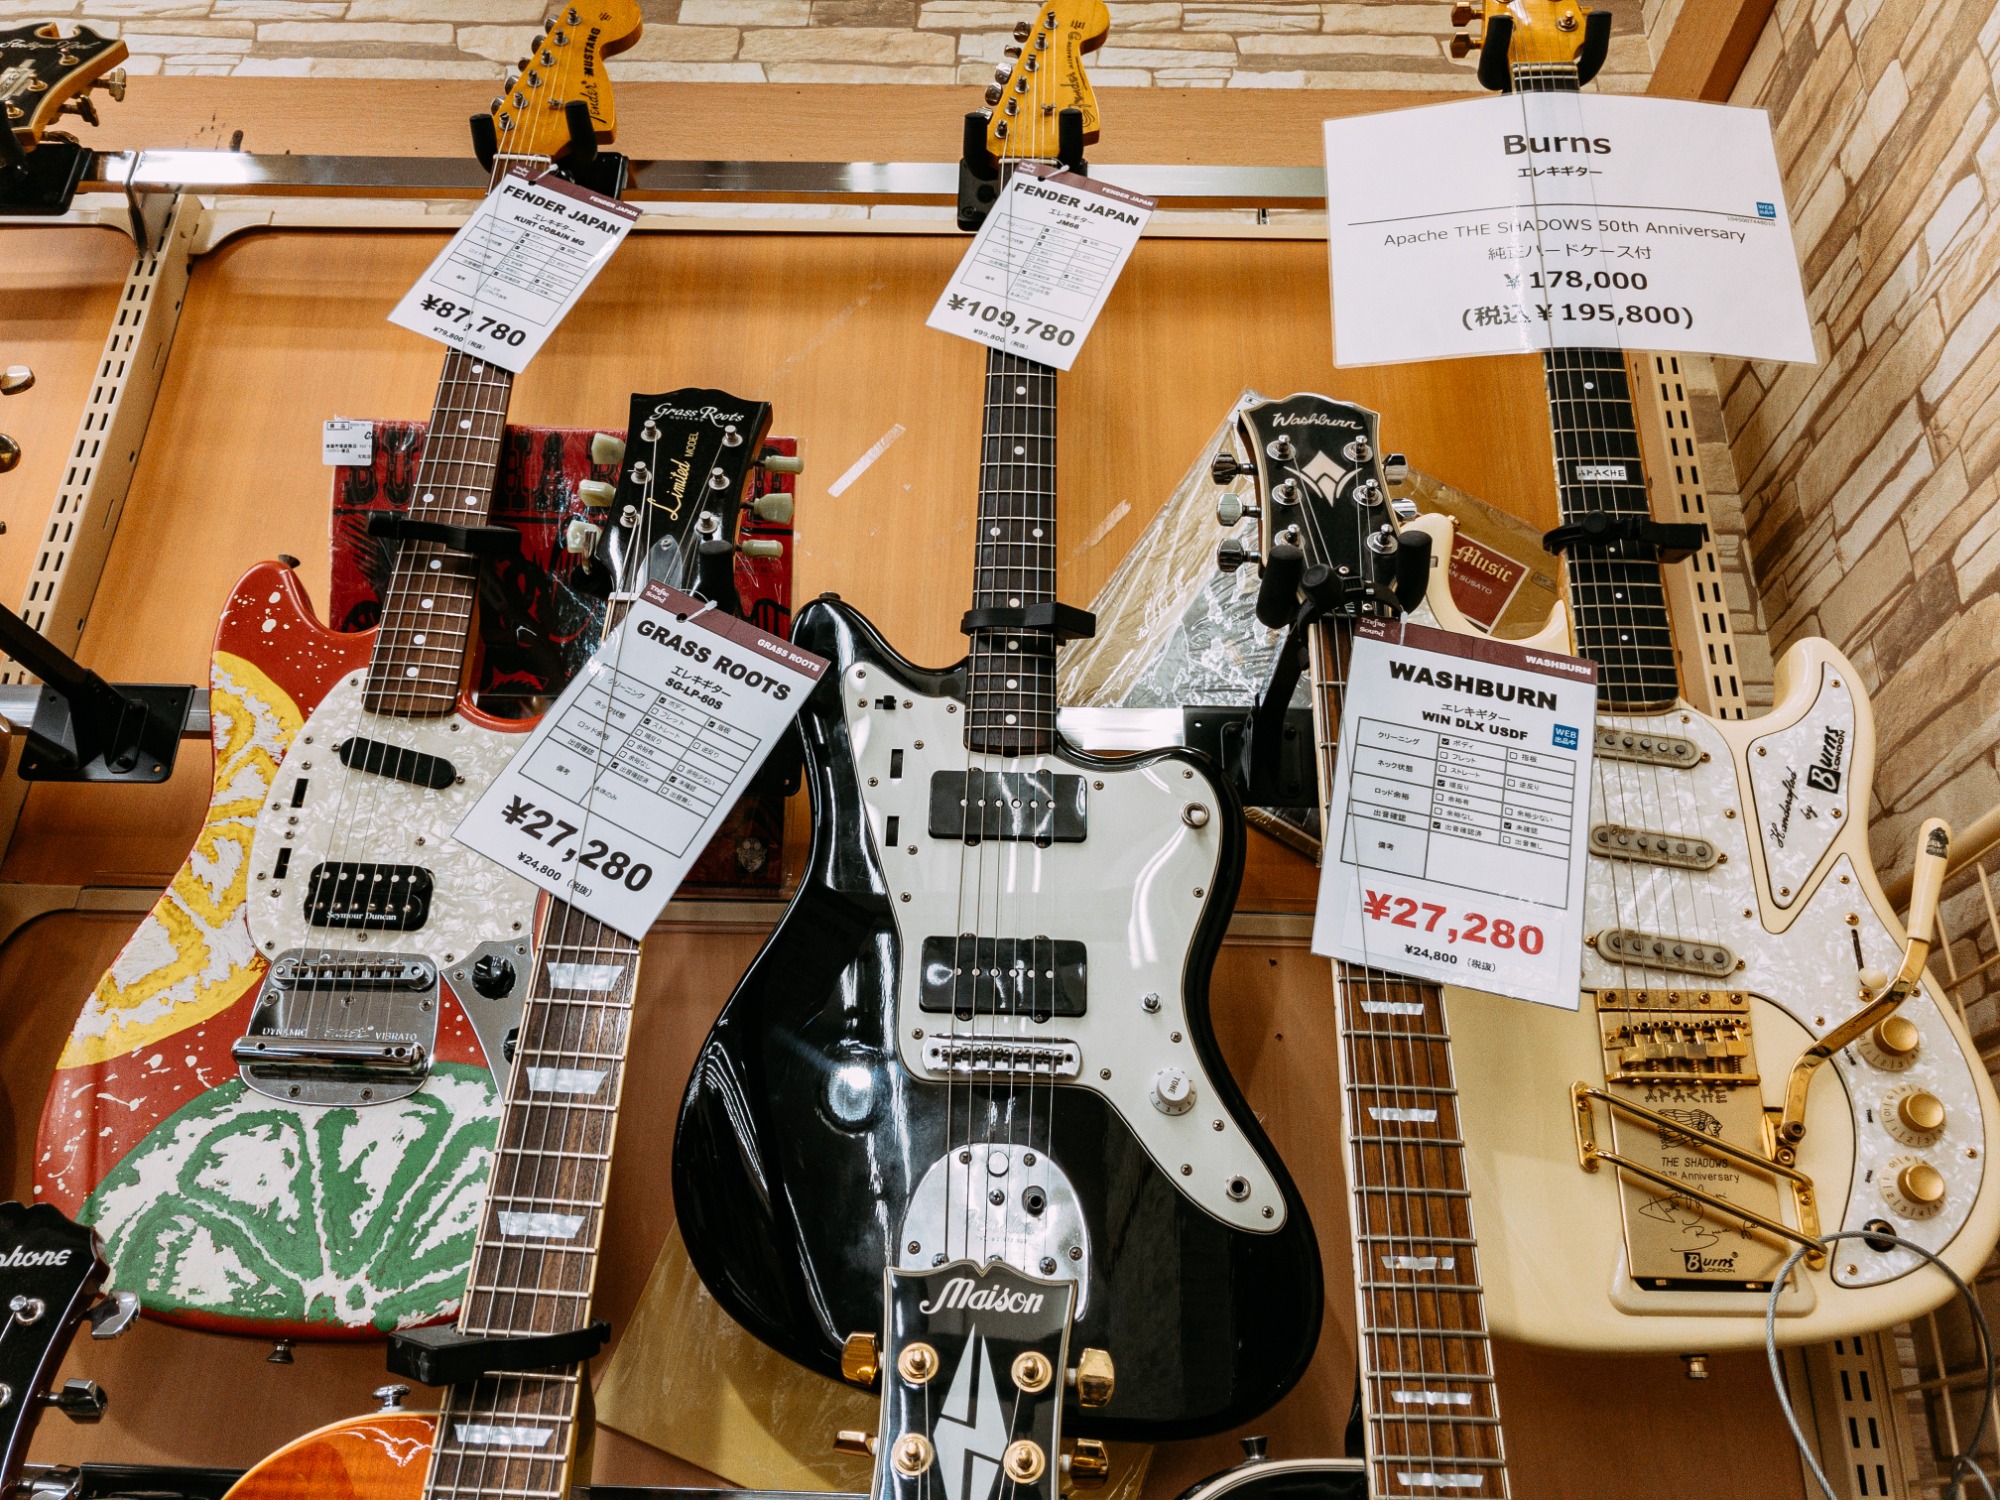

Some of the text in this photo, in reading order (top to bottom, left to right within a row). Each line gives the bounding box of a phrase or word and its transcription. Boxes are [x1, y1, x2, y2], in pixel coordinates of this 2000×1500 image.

[584, 28, 600, 77] MUSTANG
[1503, 133, 1612, 157] Burns
[1517, 166, 1603, 178] エレキギター
[1013, 183, 1140, 226] FENDER JAPAN
[1101, 187, 1153, 206] FENDER JAPAN
[502, 184, 621, 235] FENDER JAPAN
[513, 215, 536, 226] KURT
[538, 225, 570, 239] COBAIN
[571, 237, 585, 245] MG
[533, 214, 575, 233] エレキギター
[1384, 219, 1746, 247] Apache THE SHADOWS 50th Anniversary
[1488, 243, 1651, 261] 純正ハードケース付
[420, 294, 527, 347] ¥87,780
[947, 294, 1076, 346] ¥109,780
[649, 403, 744, 428] Grass Roots
[1272, 412, 1364, 430] Washburn
[647, 432, 699, 520] Limited MODEL
[1452, 546, 1513, 583] Music
[1459, 574, 1492, 595] SUSATO
[1359, 626, 1384, 637] Sound
[636, 620, 791, 700] GRASS ROOTS
[757, 638, 820, 672] GRASS ROOTS
[1526, 655, 1592, 675] WASHBURN
[672, 666, 731, 698] エレキギター
[1389, 661, 1557, 711] WASHBURN
[665, 678, 722, 709] SG-LP-60S
[593, 699, 626, 719] ネック状態
[660, 711, 685, 727] フレット
[1441, 703, 1510, 722] エレキギター
[1422, 710, 1528, 741] WIN DLX USDF
[1555, 727, 1576, 739] WEB
[1378, 731, 1420, 745] クリーニング
[1453, 740, 1474, 750] ボディ
[1452, 752, 1476, 763] フレット
[1807, 725, 1841, 794] Burns
[1833, 730, 1845, 771] LONDON
[554, 764, 571, 776] 備考
[1377, 759, 1413, 773] ネック状態
[1450, 766, 1480, 778] ストレート
[1375, 787, 1410, 801] ロッド余裕
[1374, 809, 1406, 822] 出音確認
[1446, 808, 1473, 821] 余裕なし
[1770, 766, 1818, 848] Handcrafted by
[1445, 822, 1482, 837] 出音確認済
[1516, 824, 1538, 835] 未確認
[501, 794, 653, 892] ¥27,280
[1378, 842, 1394, 850] 備考
[517, 852, 561, 881] ¥24,800
[327, 912, 397, 921] Seymour Duncan
[1364, 889, 1544, 955] ¥27,280
[1404, 944, 1458, 965] ¥24,800
[262, 1027, 307, 1036] DYNAMIC
[376, 1032, 417, 1041] VIBRATO
[1168, 1077, 1181, 1094] TONE
[1645, 1089, 1727, 1103] APACHE
[1662, 1157, 1728, 1168] THE SHADOWS
[1681, 1171, 1740, 1183] Anniversary
[1684, 1252, 1734, 1272] Burns
[919, 1278, 1044, 1314] Maison
